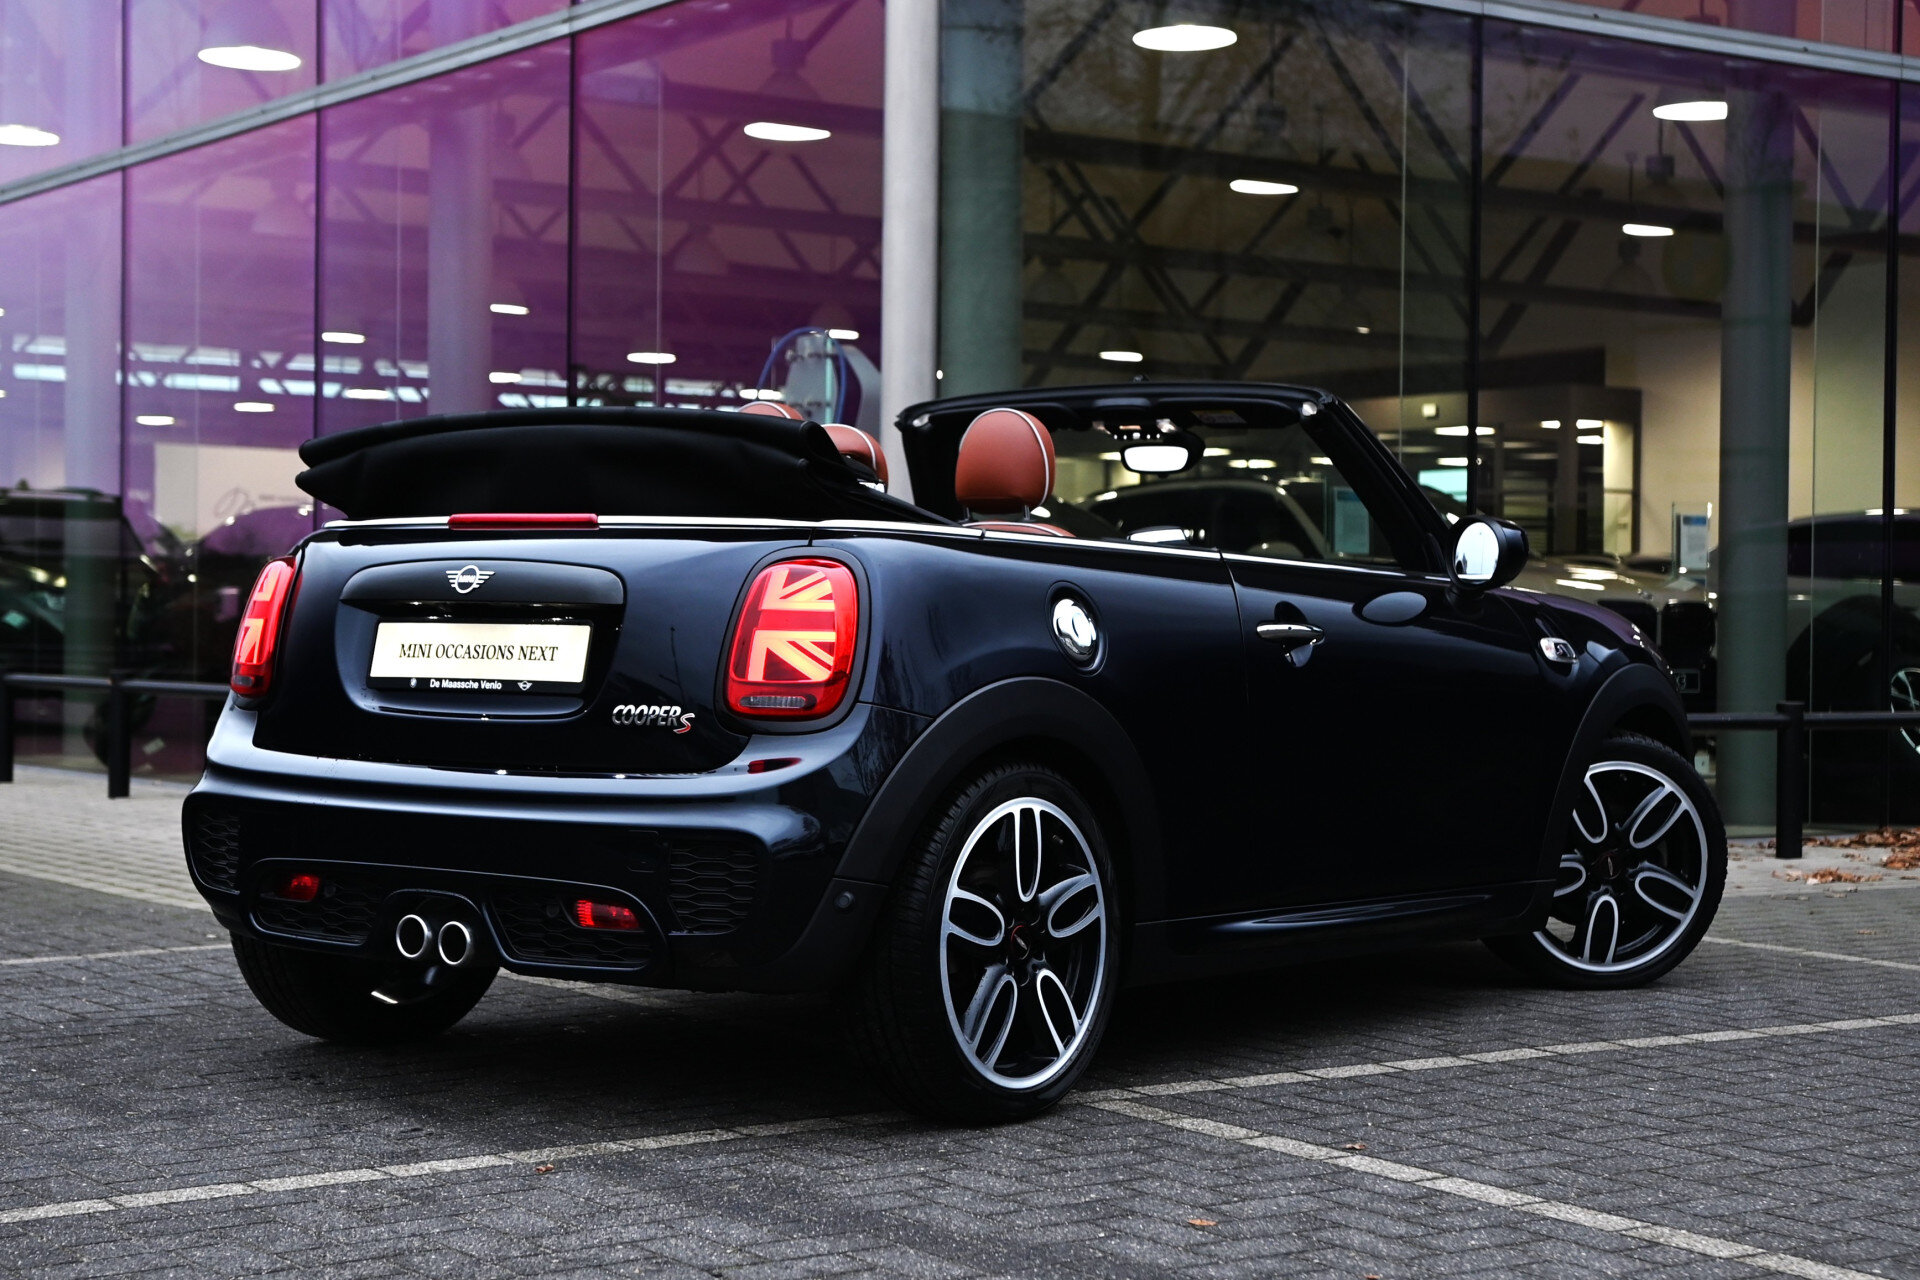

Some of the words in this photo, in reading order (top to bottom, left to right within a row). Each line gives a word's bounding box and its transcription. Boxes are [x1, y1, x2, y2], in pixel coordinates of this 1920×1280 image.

[399, 644, 432, 658] MINI
[435, 644, 514, 660] OCCASIONS
[517, 645, 559, 662] NEXT
[430, 679, 440, 688] De
[442, 679, 479, 689] Maassche
[481, 680, 502, 689] Venlo
[612, 704, 682, 727] COOPER
[673, 712, 696, 734] S
